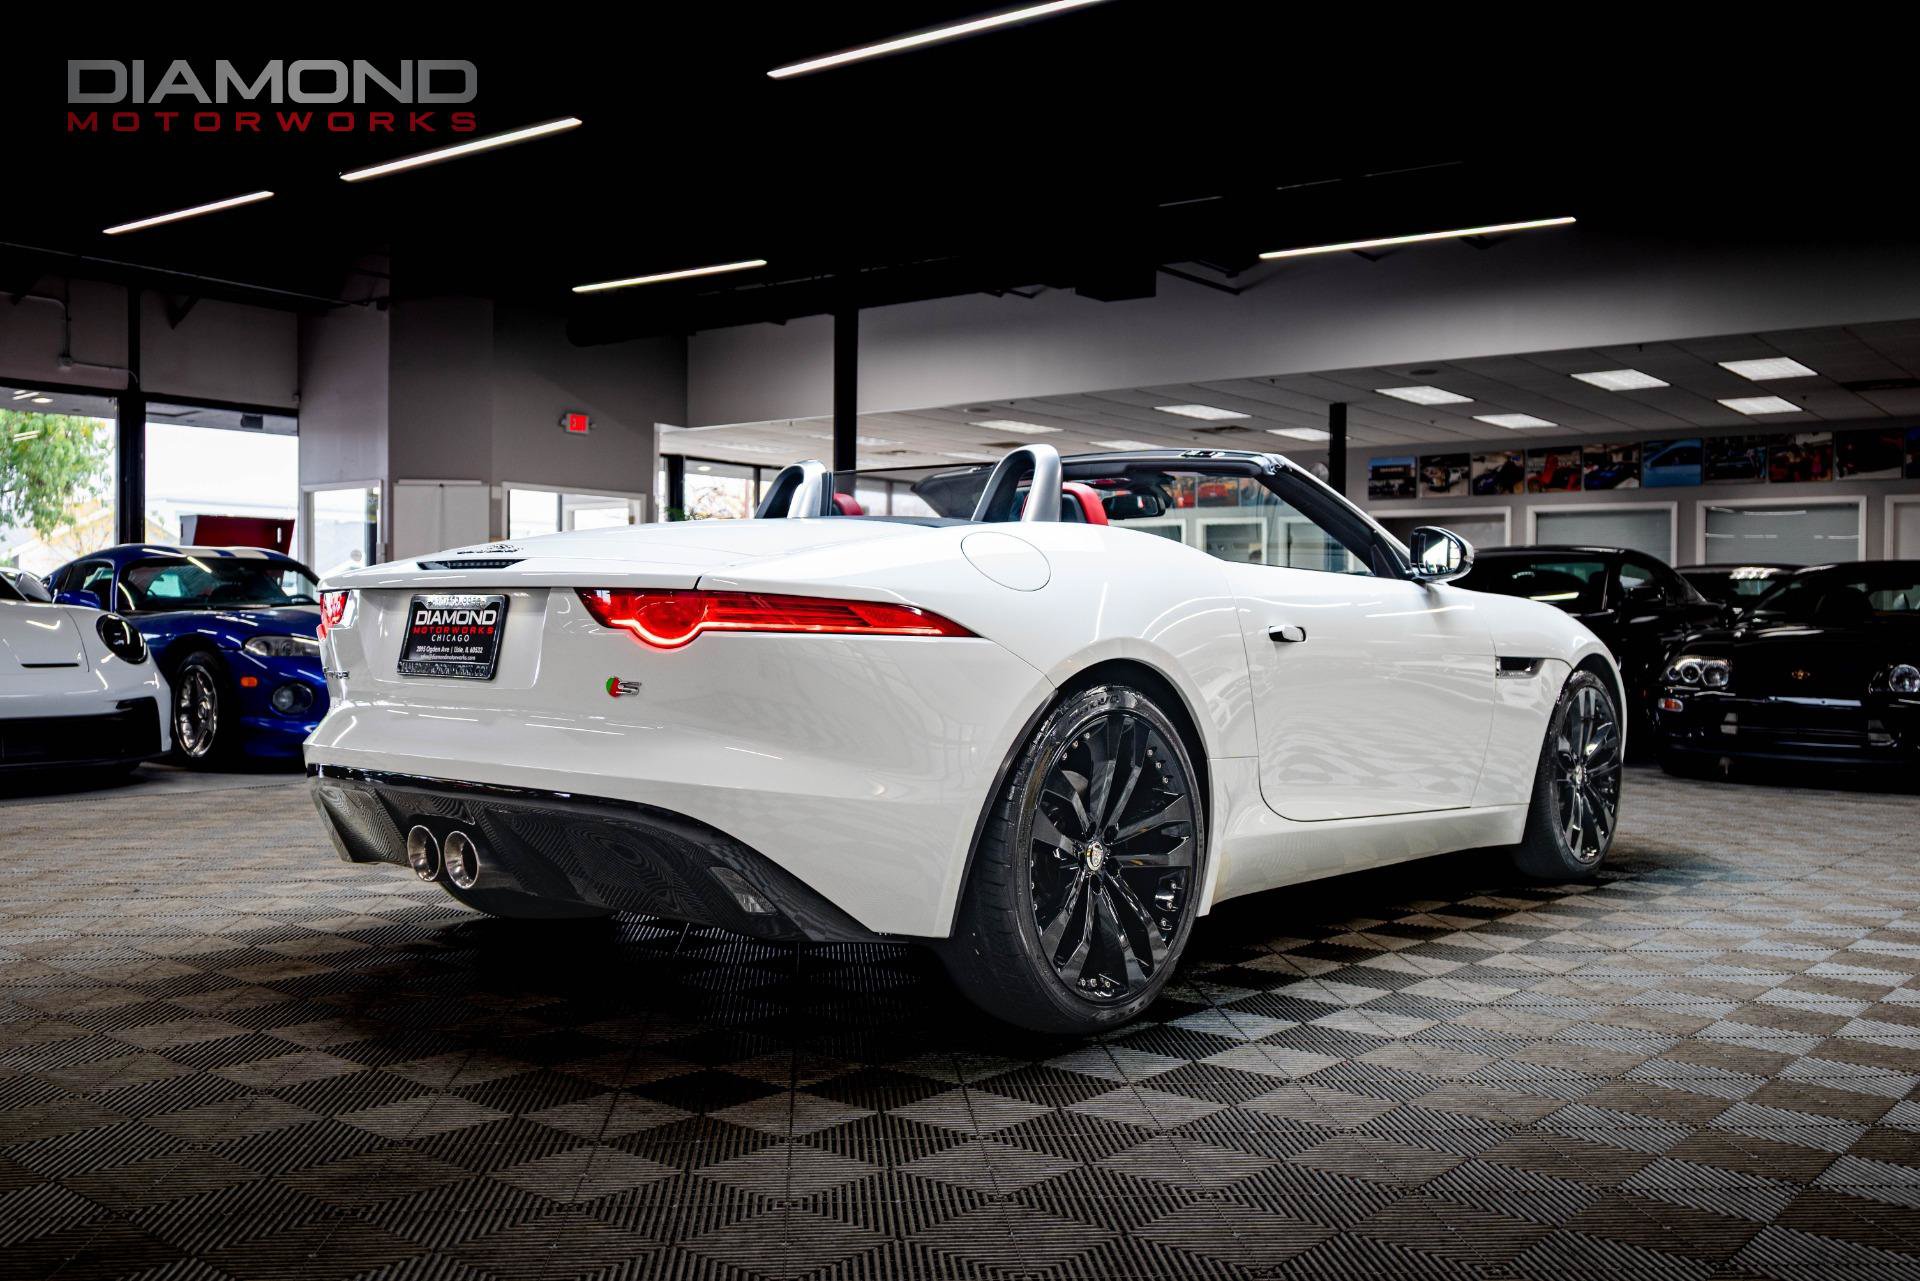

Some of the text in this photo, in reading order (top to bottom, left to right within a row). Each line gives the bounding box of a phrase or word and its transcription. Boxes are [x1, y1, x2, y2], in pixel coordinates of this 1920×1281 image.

[415, 610, 497, 625] DIAMOND
[413, 626, 495, 635] MOTORWORKS
[431, 634, 470, 642] CHICAGO
